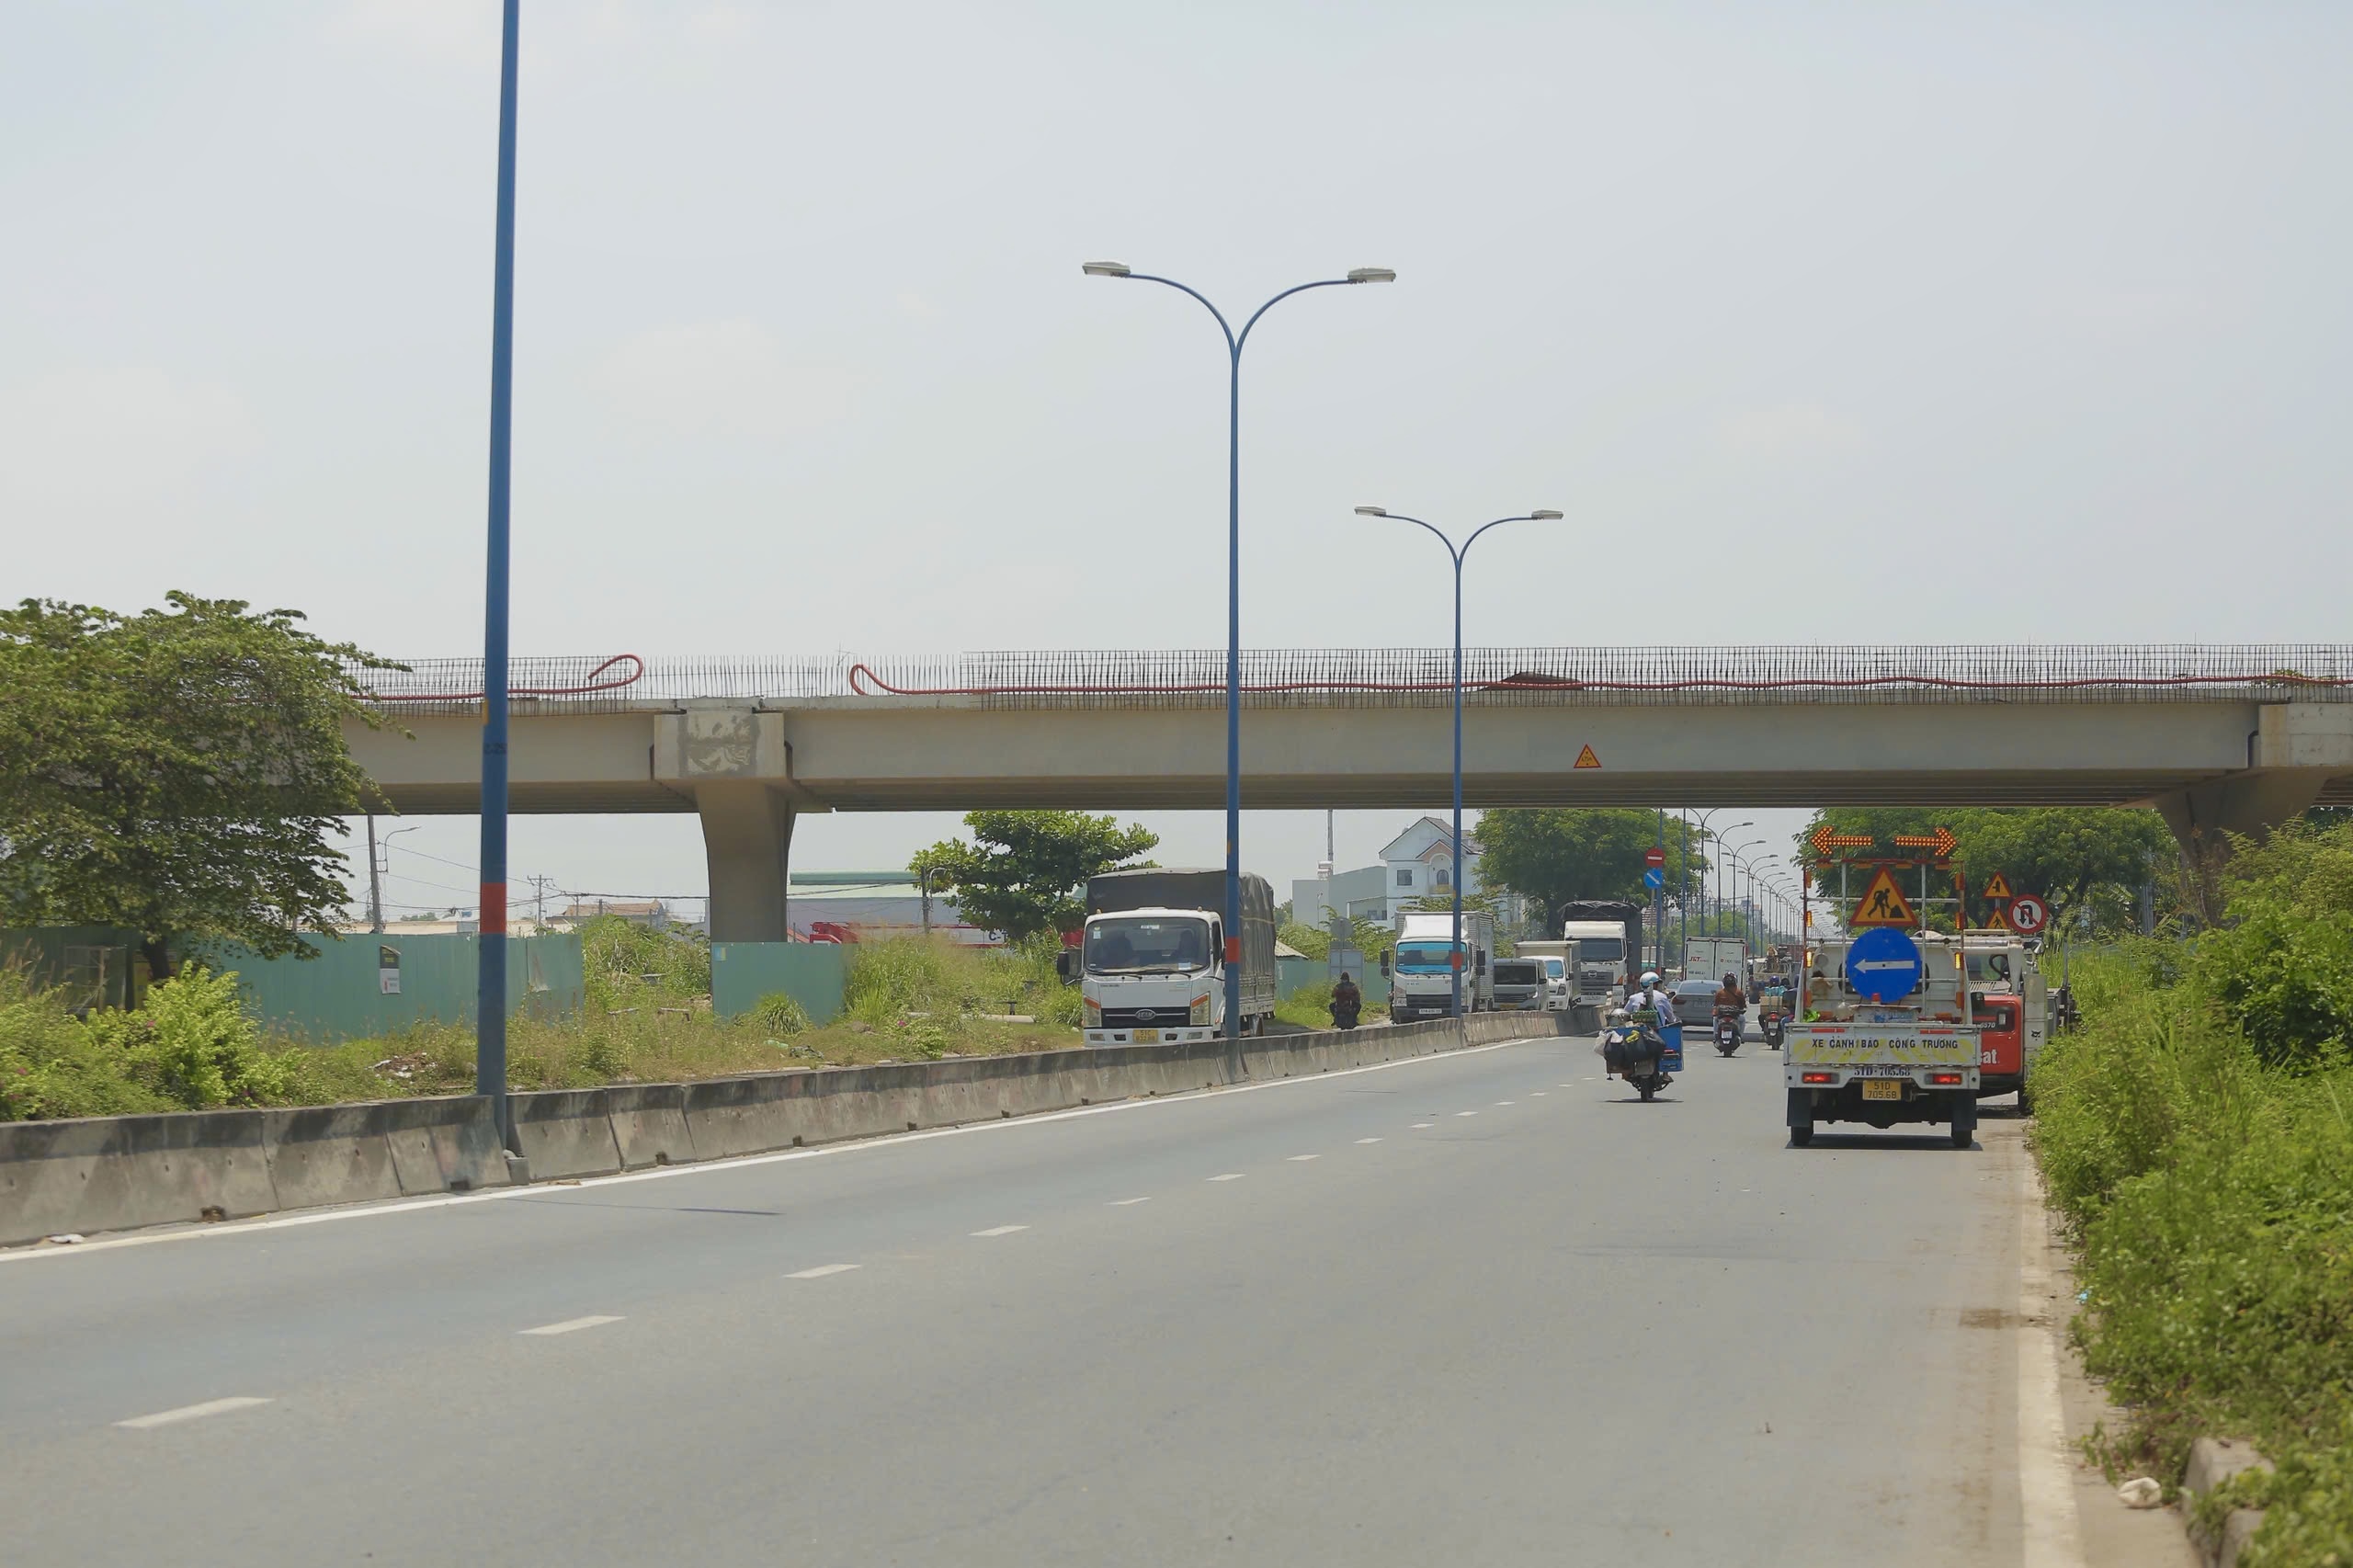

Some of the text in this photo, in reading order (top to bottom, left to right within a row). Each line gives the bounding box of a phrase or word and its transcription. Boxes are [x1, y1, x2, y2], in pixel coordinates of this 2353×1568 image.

[1812, 1039, 1824, 1048] XE
[1874, 1082, 1891, 1090] 51D
[1868, 1091, 1897, 1099] 705.68
